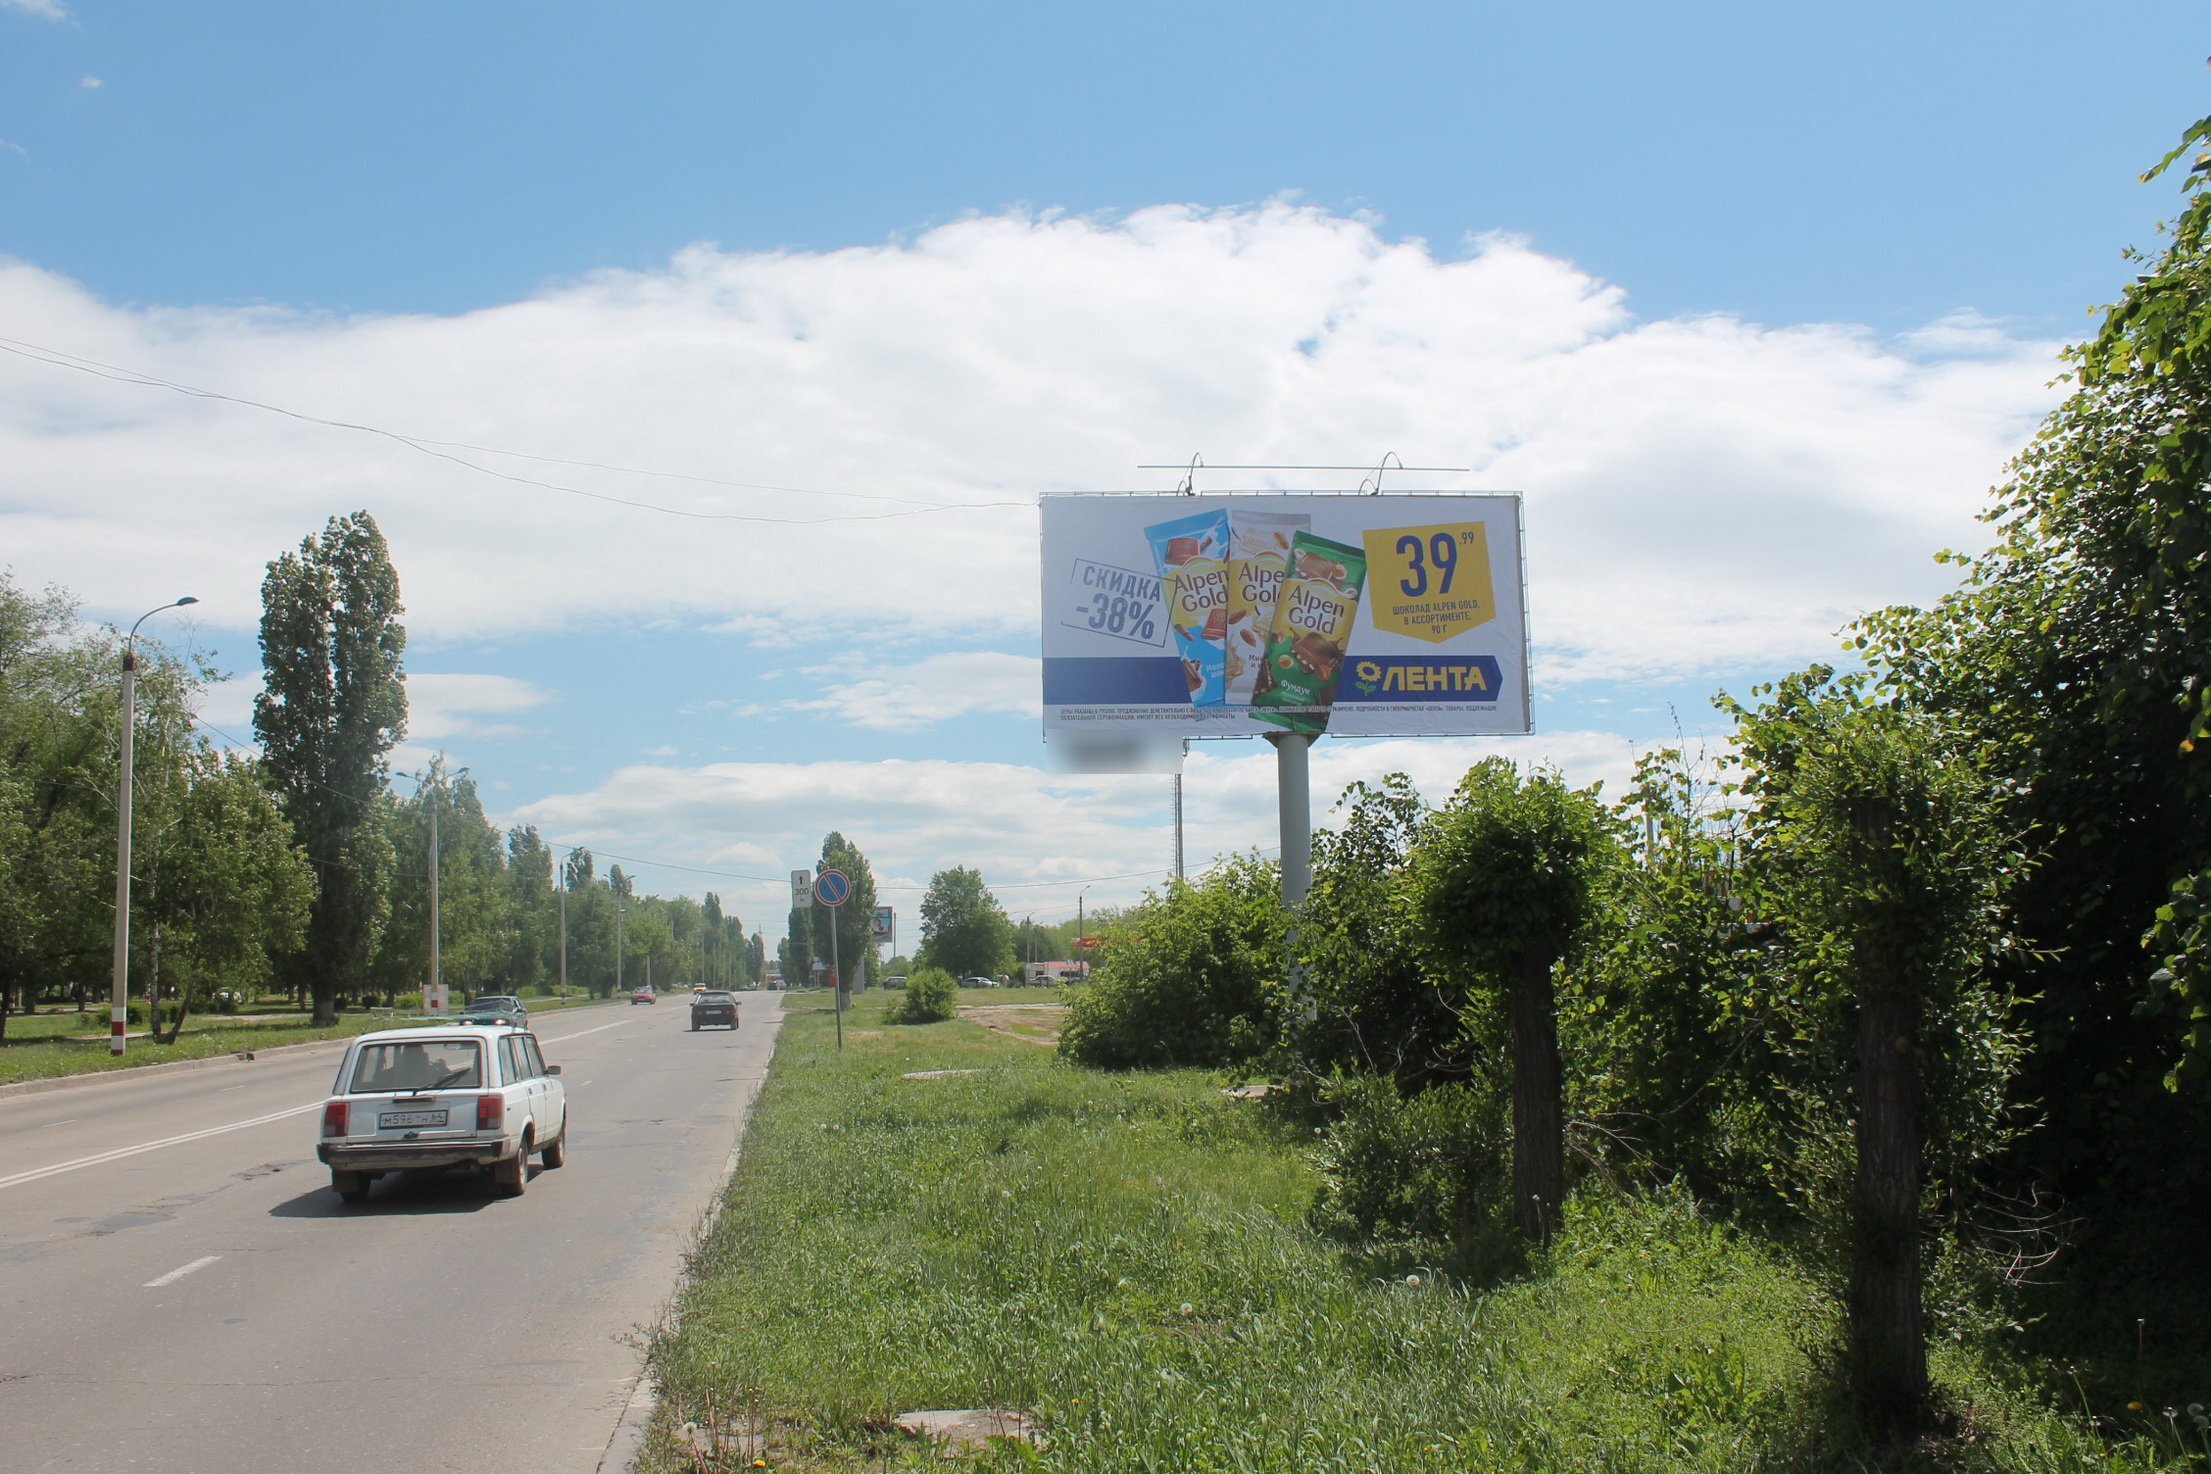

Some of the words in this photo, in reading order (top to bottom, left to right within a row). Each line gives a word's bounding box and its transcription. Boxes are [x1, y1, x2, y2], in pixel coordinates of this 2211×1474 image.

[1396, 532, 1457, 597] 39
[1082, 565, 1160, 602] СКИДКА
[1175, 569, 1229, 595] Alpen
[1241, 584, 1281, 603] Gol
[1181, 584, 1229, 612] Gold
[1288, 584, 1345, 617] Alpen
[1392, 602, 1431, 616] ШОКОЛАД
[1432, 601, 1457, 613] ALPEN
[1076, 592, 1155, 640] -38%
[1288, 606, 1336, 635] Gold
[1403, 616, 1409, 625] В
[1431, 624, 1441, 634] 90
[1280, 679, 1312, 696] Фундук
[1381, 666, 1488, 691] ЛЕНТА
[795, 887, 809, 896] 300
